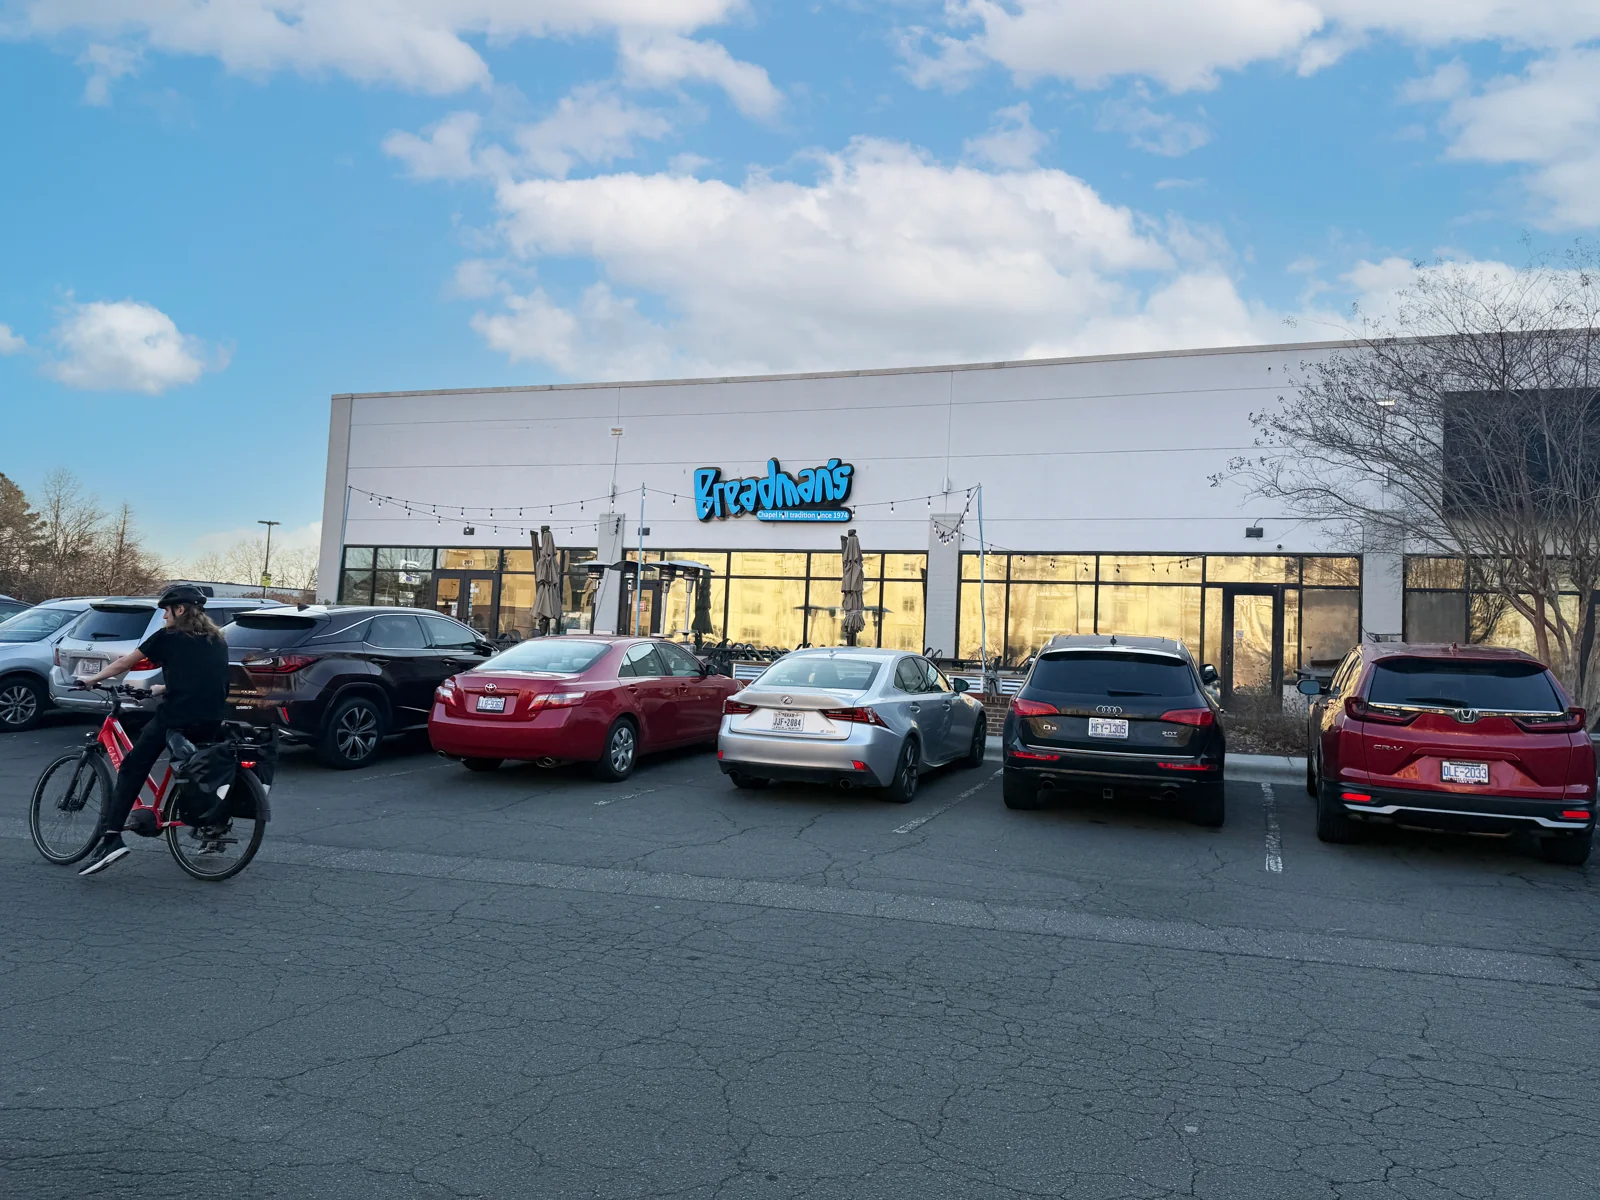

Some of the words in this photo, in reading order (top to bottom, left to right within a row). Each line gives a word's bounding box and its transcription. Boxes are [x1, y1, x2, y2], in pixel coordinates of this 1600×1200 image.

[694, 458, 853, 521] Breadman's
[757, 510, 777, 519] Chapel
[779, 511, 788, 519] Hll
[789, 511, 816, 519] tradition
[818, 511, 832, 519] ince
[833, 511, 848, 519] 1974
[1091, 722, 1126, 734] HFY-1305
